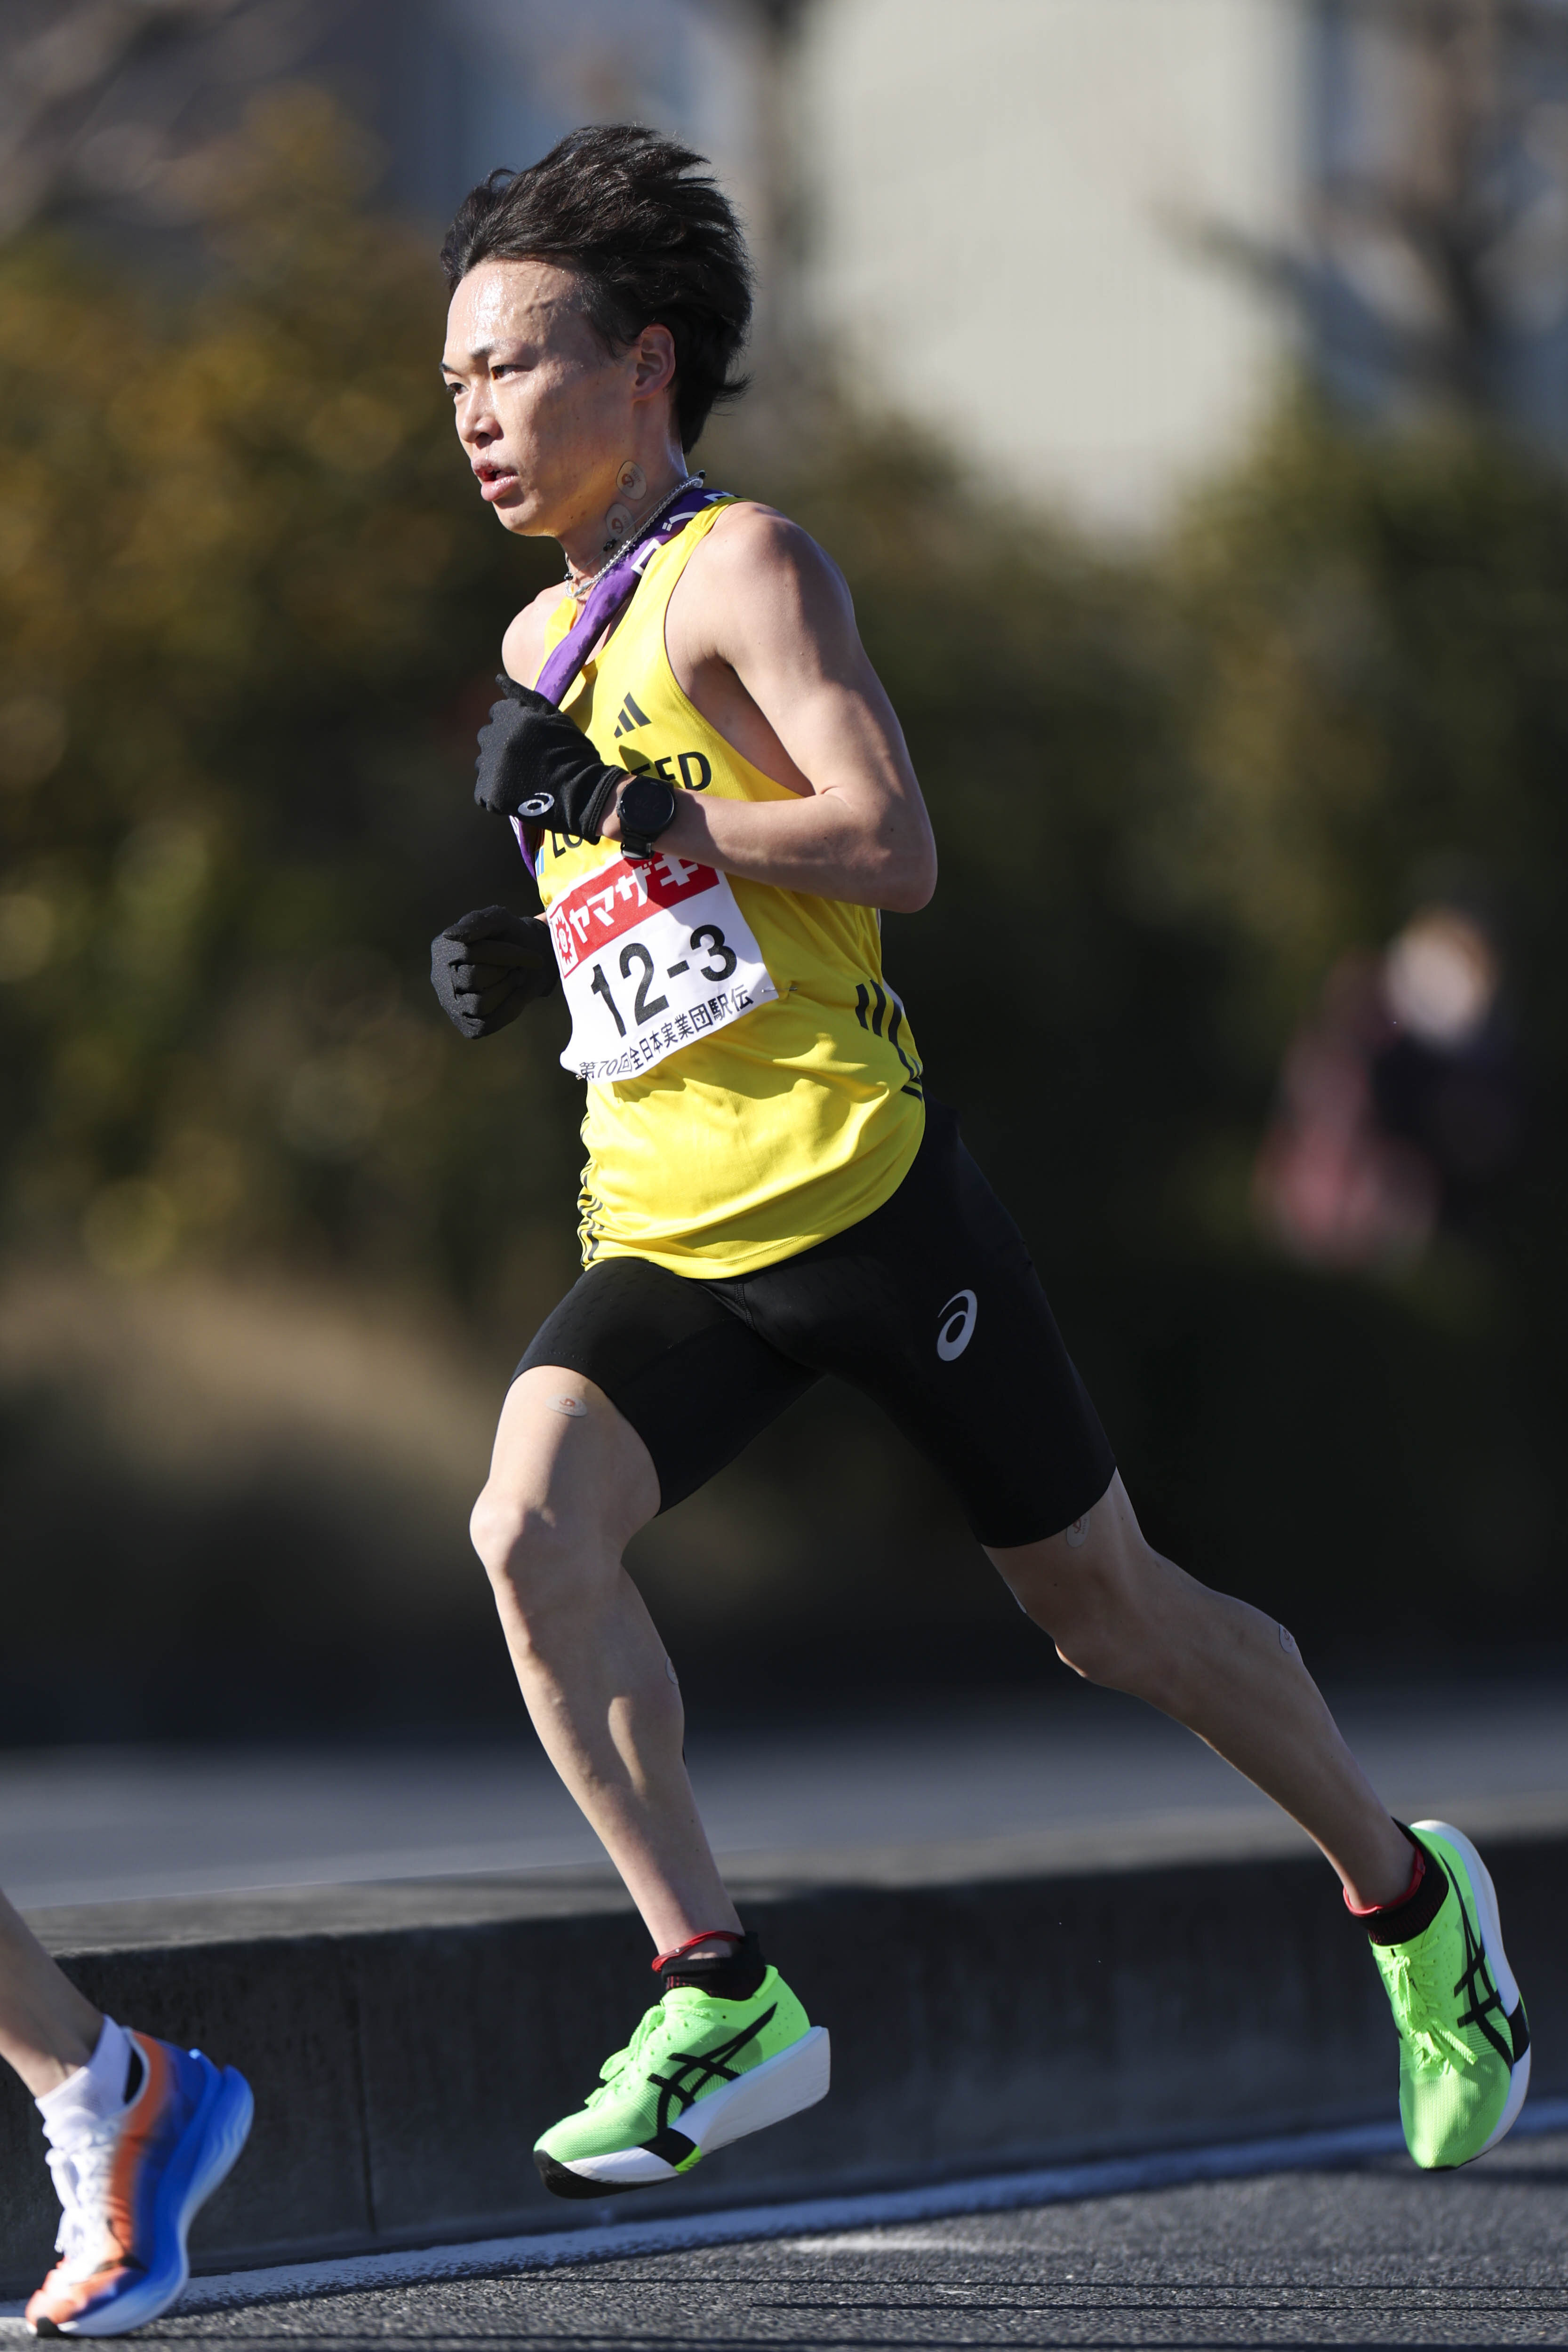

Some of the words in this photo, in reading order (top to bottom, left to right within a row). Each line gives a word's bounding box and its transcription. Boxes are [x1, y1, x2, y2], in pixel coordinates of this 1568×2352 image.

[569, 855, 698, 944] ヤマザキ
[591, 924, 737, 1038] 12-3
[579, 984, 754, 1081] 第70回全日本実業団駅伝
